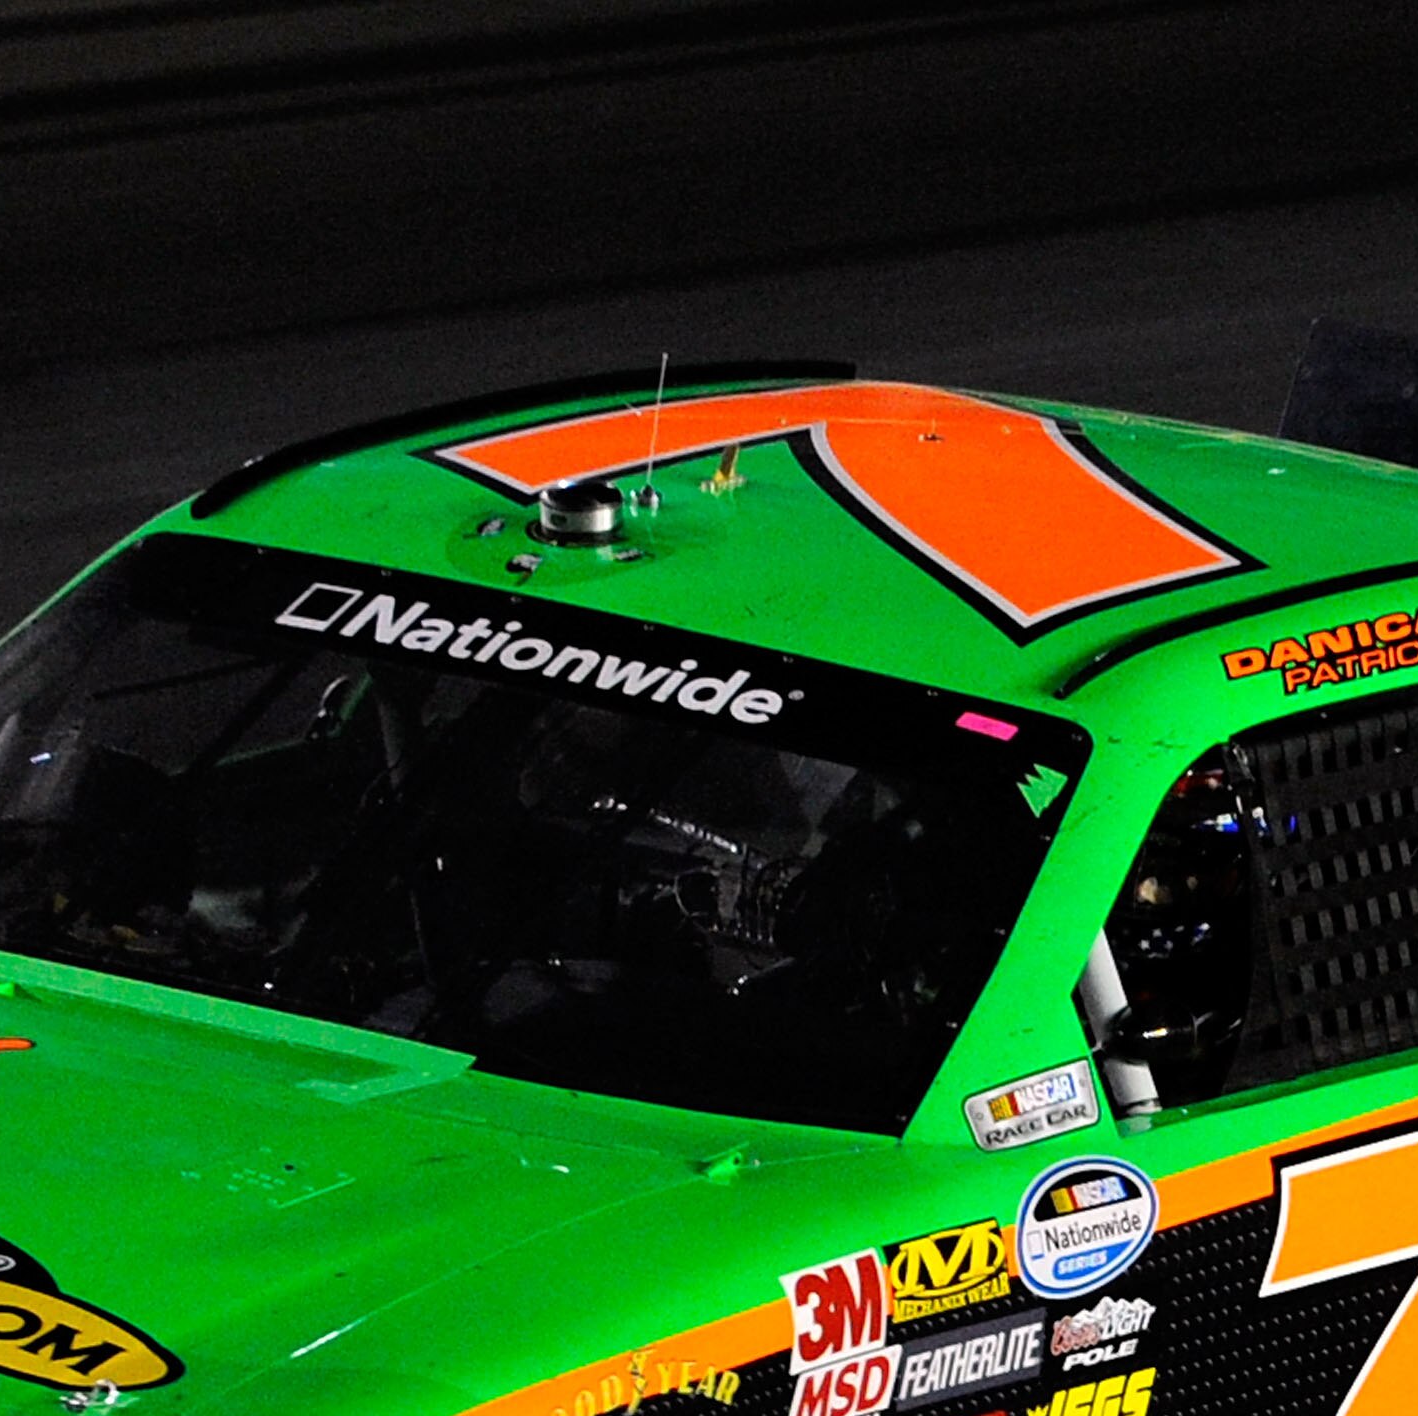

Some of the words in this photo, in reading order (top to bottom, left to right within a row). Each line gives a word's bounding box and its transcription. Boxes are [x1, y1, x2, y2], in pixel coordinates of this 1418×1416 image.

[434, 380, 1240, 627] 7
[339, 594, 783, 726] Nationwide
[1015, 1073, 1078, 1115] NASCAR
[985, 1119, 1044, 1147] RACE
[1046, 1104, 1088, 1126] CAR
[1045, 1209, 1142, 1254] Nationwide
[794, 1253, 882, 1362] 3M
[968, 1272, 1011, 1304] WEAR
[898, 1322, 1043, 1401] FEATHERLITE
[1062, 1338, 1139, 1371] POLE
